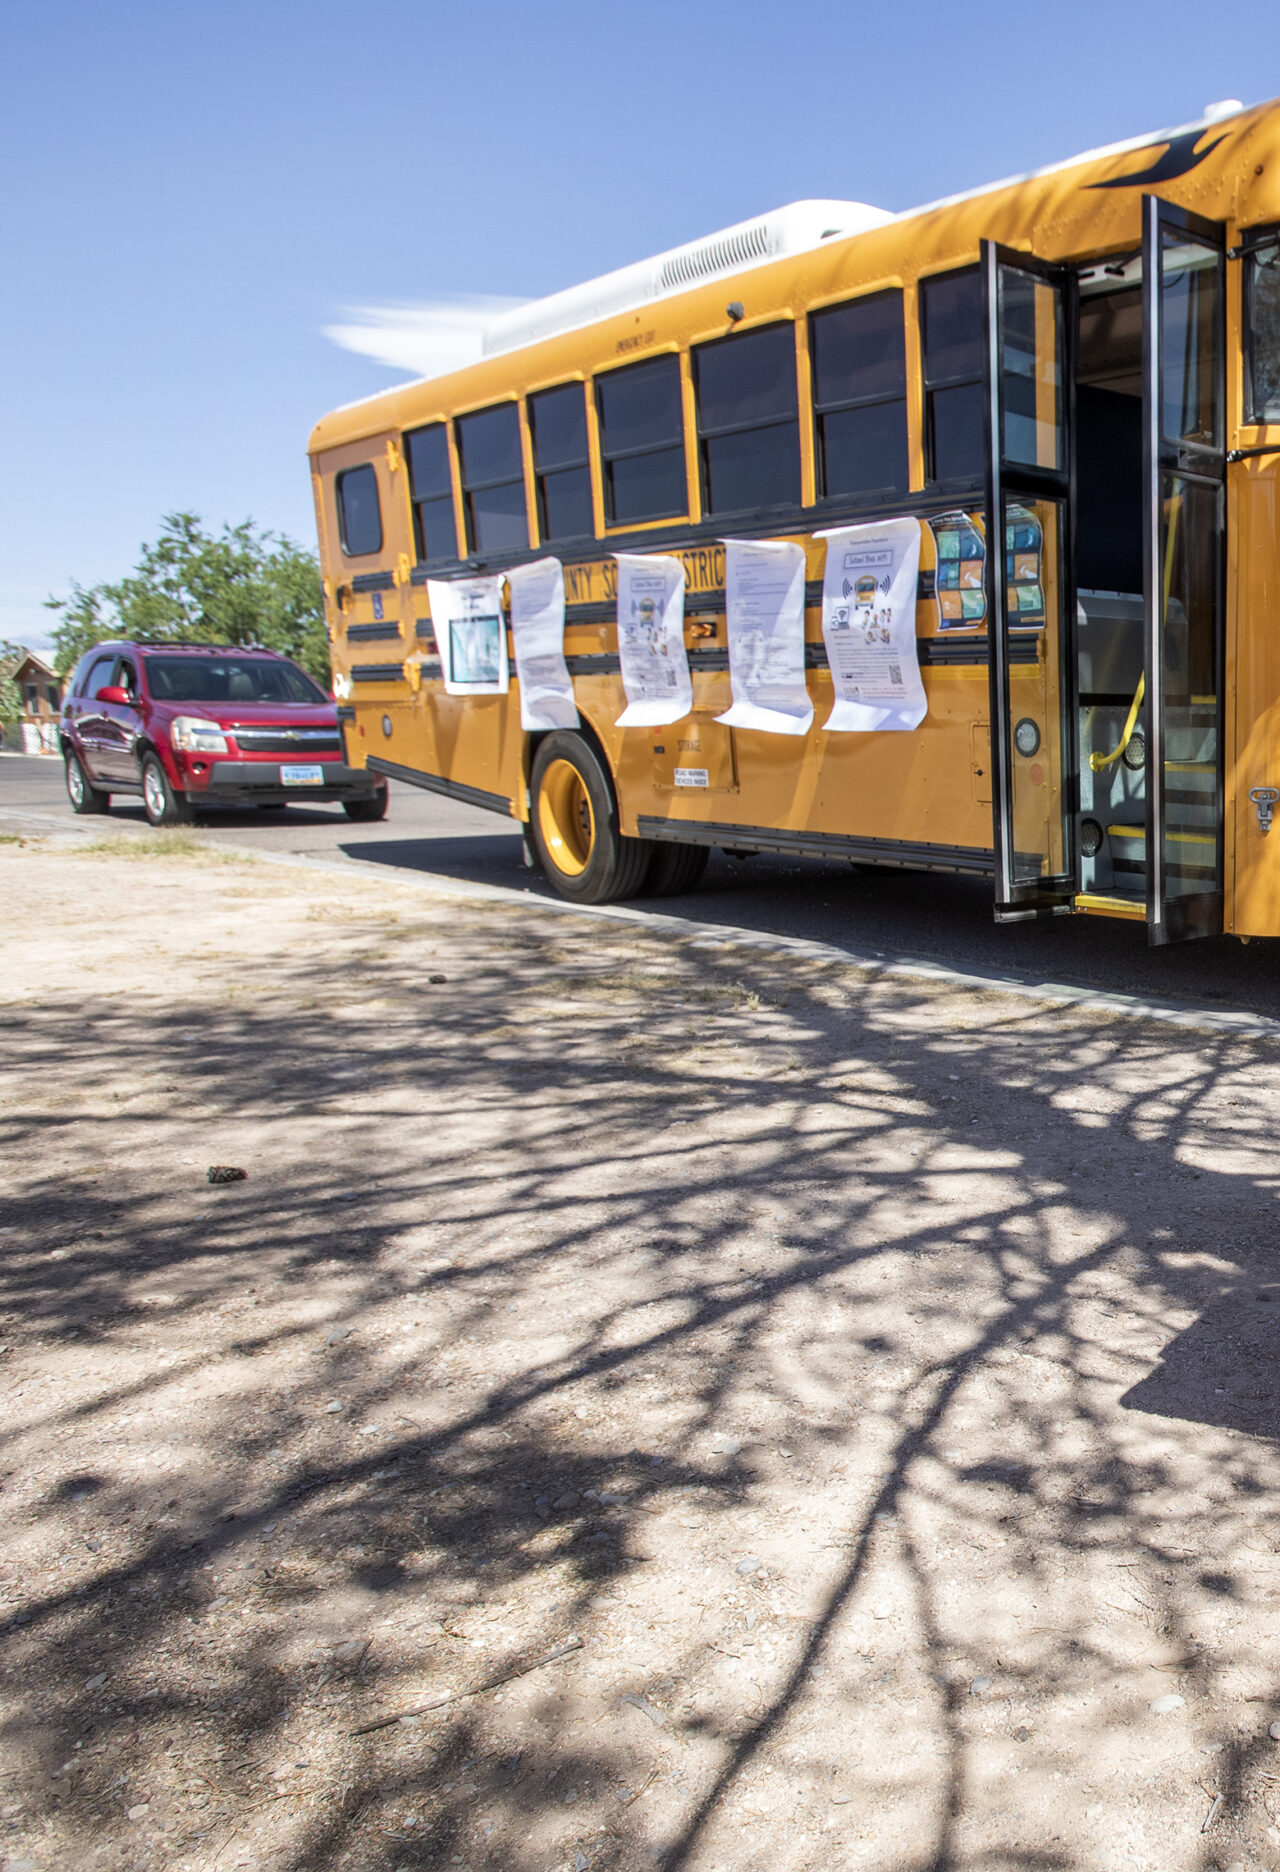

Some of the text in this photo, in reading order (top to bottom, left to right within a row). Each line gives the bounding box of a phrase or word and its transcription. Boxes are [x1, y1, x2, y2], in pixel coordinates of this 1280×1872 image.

[865, 554, 876, 563] Bus
[677, 547, 726, 589] STRIC
[677, 739, 702, 752] STORAGE
